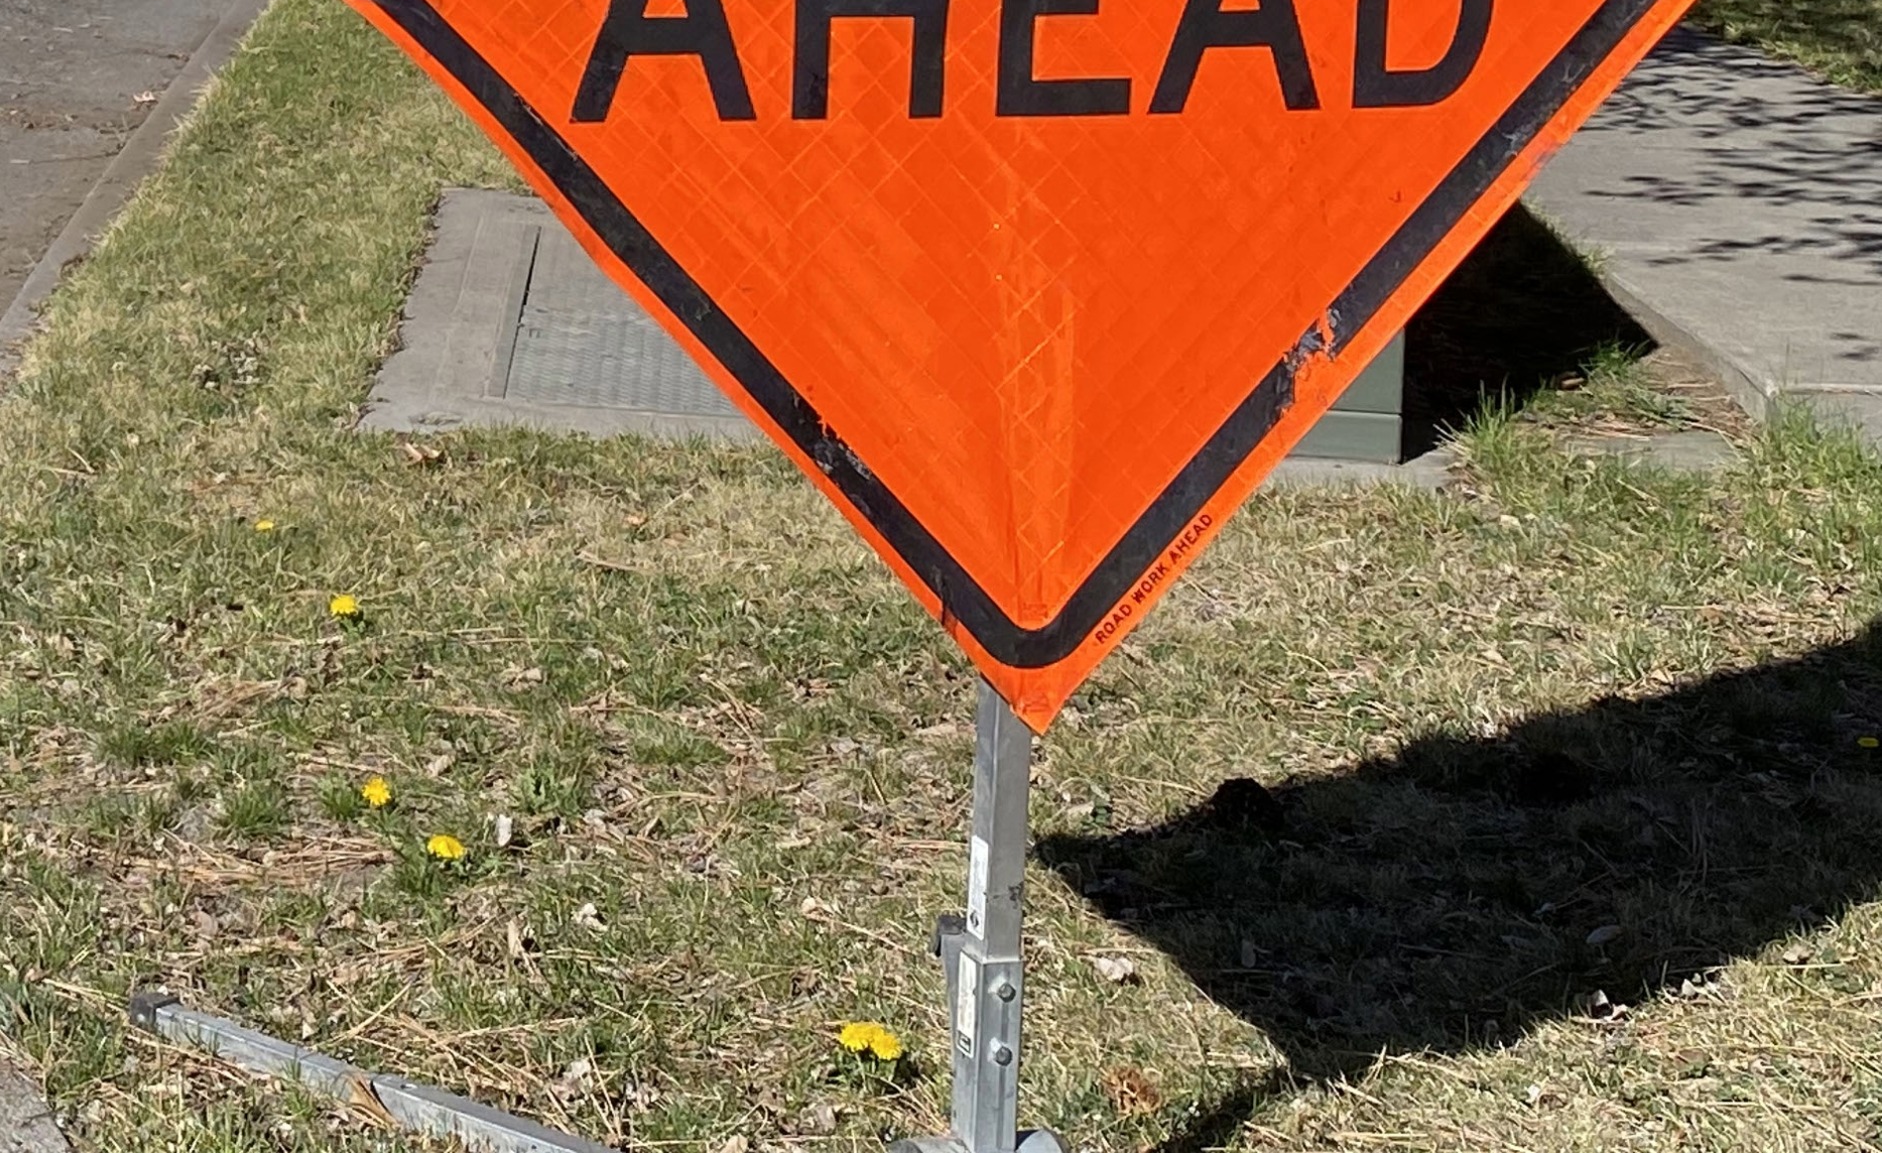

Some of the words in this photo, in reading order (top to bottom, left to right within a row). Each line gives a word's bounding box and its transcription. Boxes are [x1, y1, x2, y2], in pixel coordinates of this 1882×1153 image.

[1095, 604, 1132, 644] ROAD
[1131, 563, 1169, 605] WORK
[1168, 514, 1213, 564] AHEAD
